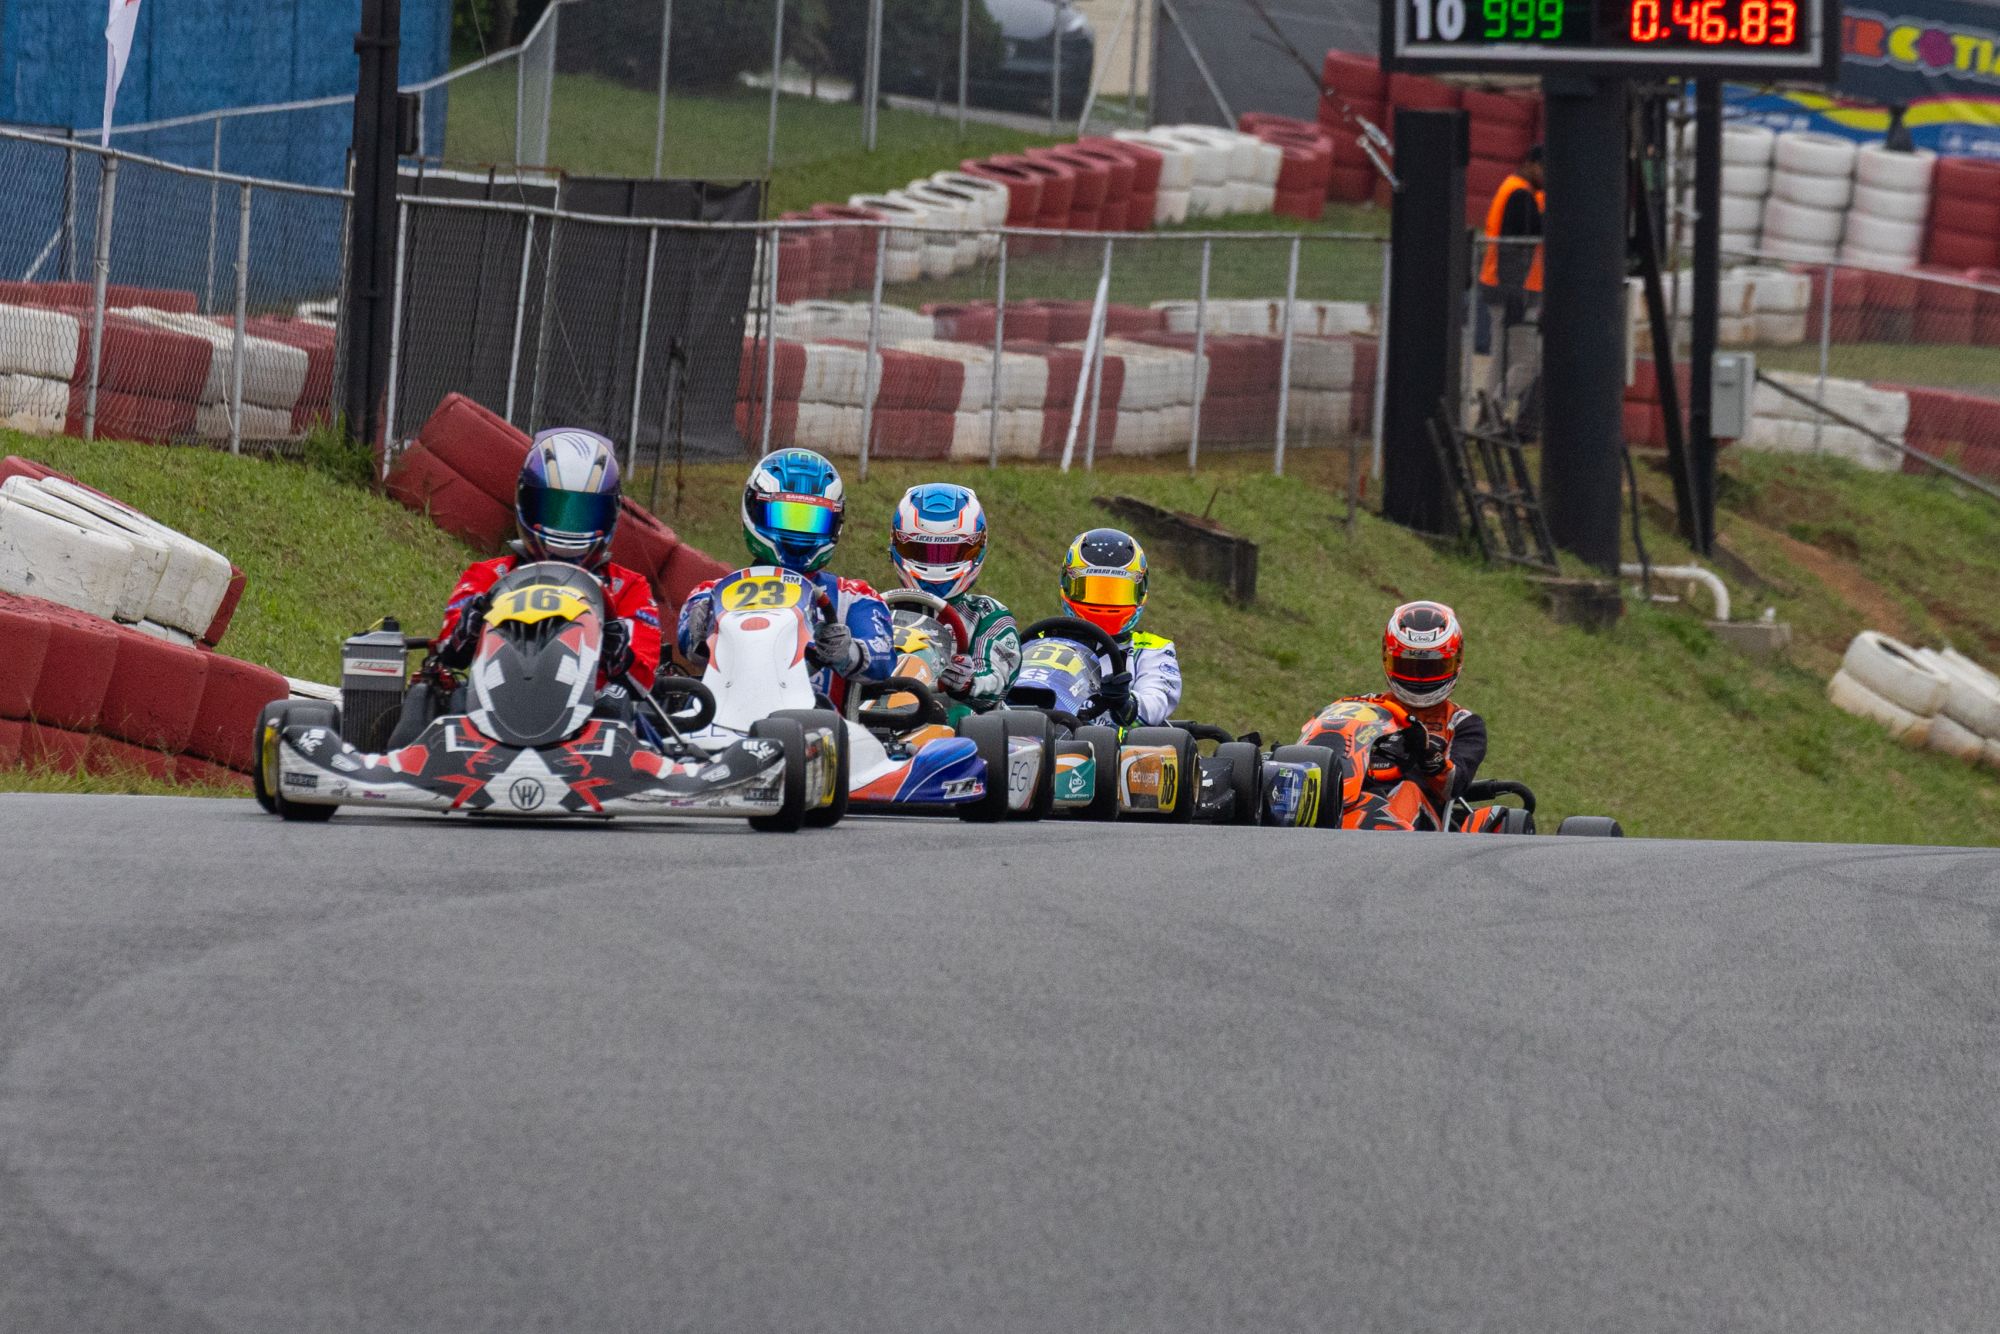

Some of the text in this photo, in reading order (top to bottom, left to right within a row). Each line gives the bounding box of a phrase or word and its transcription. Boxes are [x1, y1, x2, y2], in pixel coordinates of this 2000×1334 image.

[1413, 0, 1466, 41] 10
[1482, 0, 1564, 38] 999
[1631, 0, 1798, 45] 0.46.83
[916, 535, 933, 543] LUCAS
[783, 575, 800, 584] RM
[508, 588, 562, 614] 16
[734, 580, 785, 608] 23
